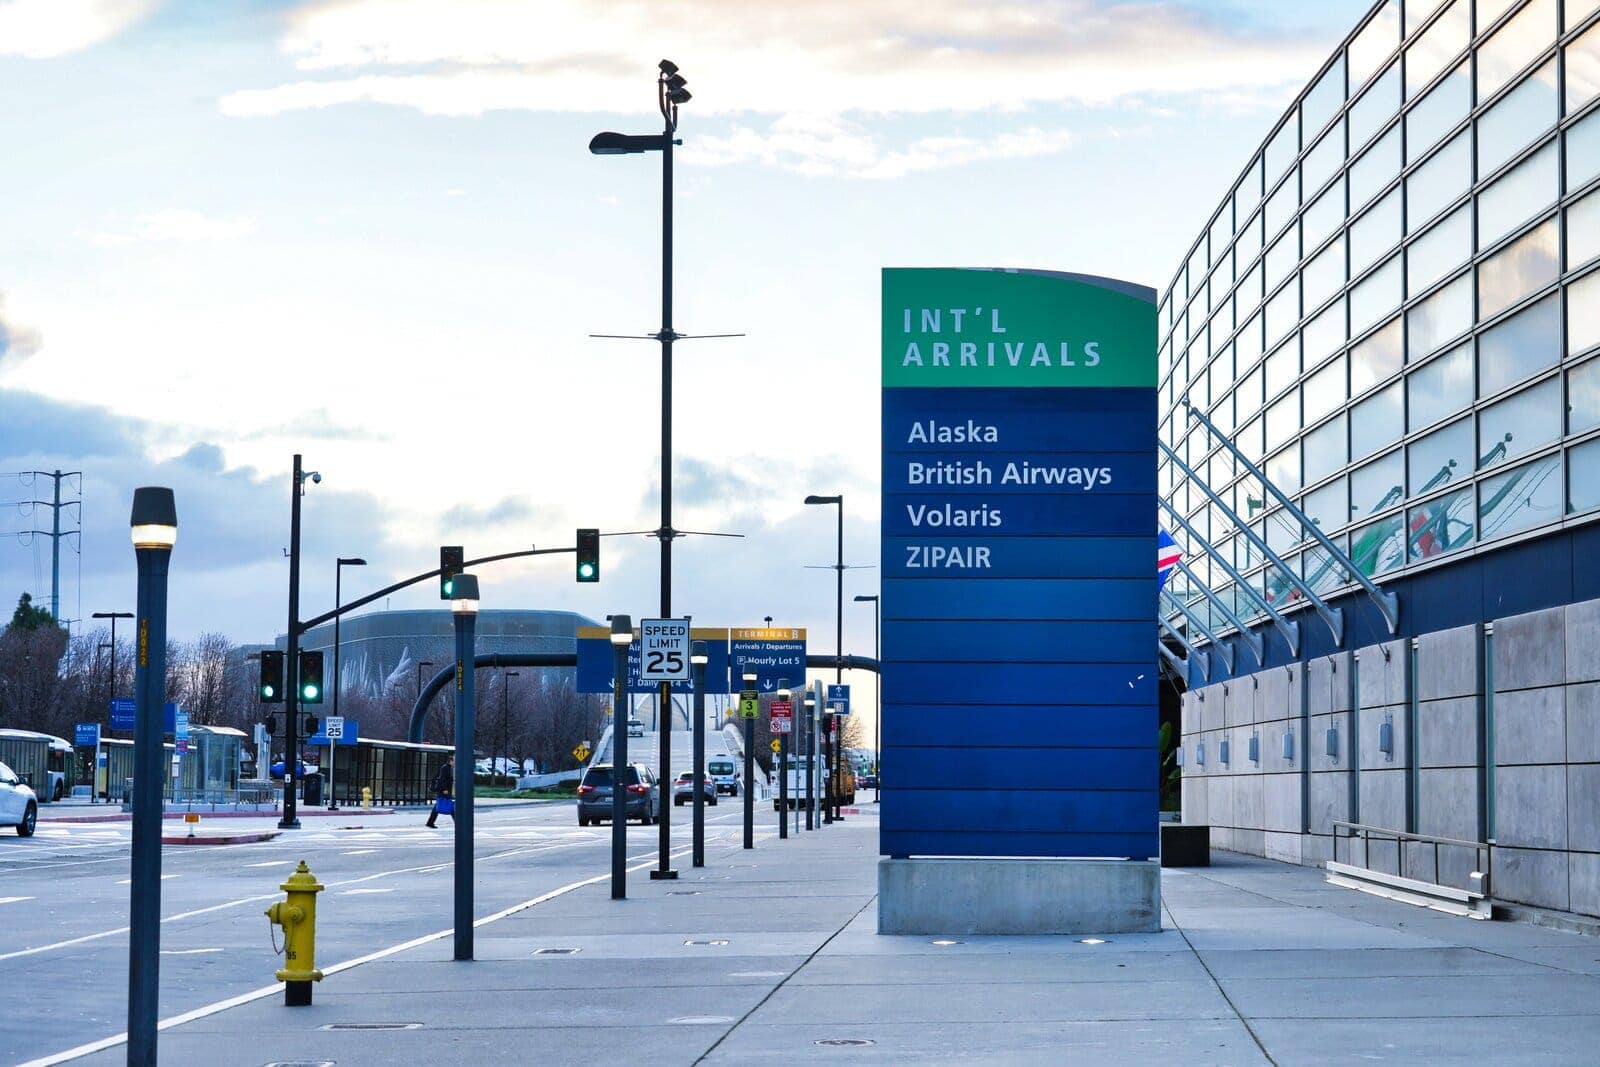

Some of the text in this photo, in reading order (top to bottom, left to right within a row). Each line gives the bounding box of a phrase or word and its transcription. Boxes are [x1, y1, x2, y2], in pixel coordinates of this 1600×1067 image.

[902, 342, 1101, 367] ARRIVALS
[907, 420, 999, 443] Alaska
[908, 461, 1112, 491] British Airways
[906, 503, 1002, 527] Volaris
[905, 546, 992, 568] ZIPAIR
[645, 626, 686, 636] SPEED
[738, 630, 789, 638] TERMINAL
[649, 638, 681, 648] LIMIT
[766, 643, 802, 651] Departures
[646, 651, 684, 673] 25
[747, 656, 776, 666] Hourly
[779, 656, 792, 665] Lot
[794, 656, 800, 665] 5
[746, 701, 753, 710] 3
[327, 728, 342, 737] 25
